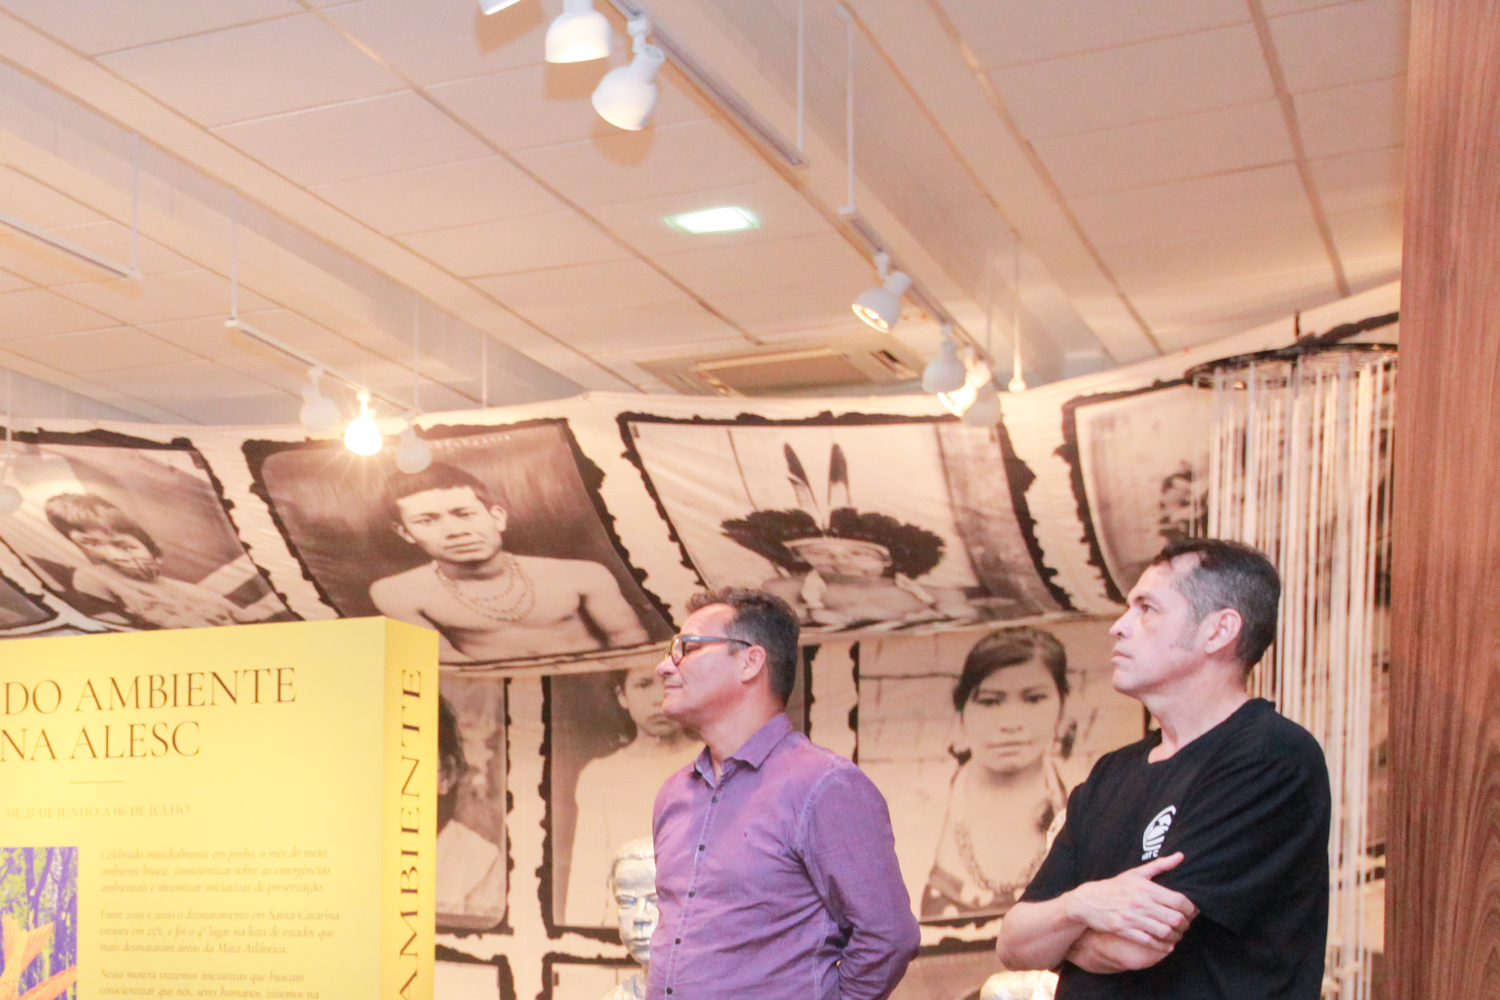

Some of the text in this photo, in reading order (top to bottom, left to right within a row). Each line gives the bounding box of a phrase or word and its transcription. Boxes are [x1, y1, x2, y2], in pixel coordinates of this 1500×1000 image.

[4, 679, 62, 716] DO
[74, 667, 296, 713] AMBIENTE
[0, 720, 200, 762] NA ALESC
[57, 806, 99, 820] JUNHO
[149, 803, 190, 818] JULHO
